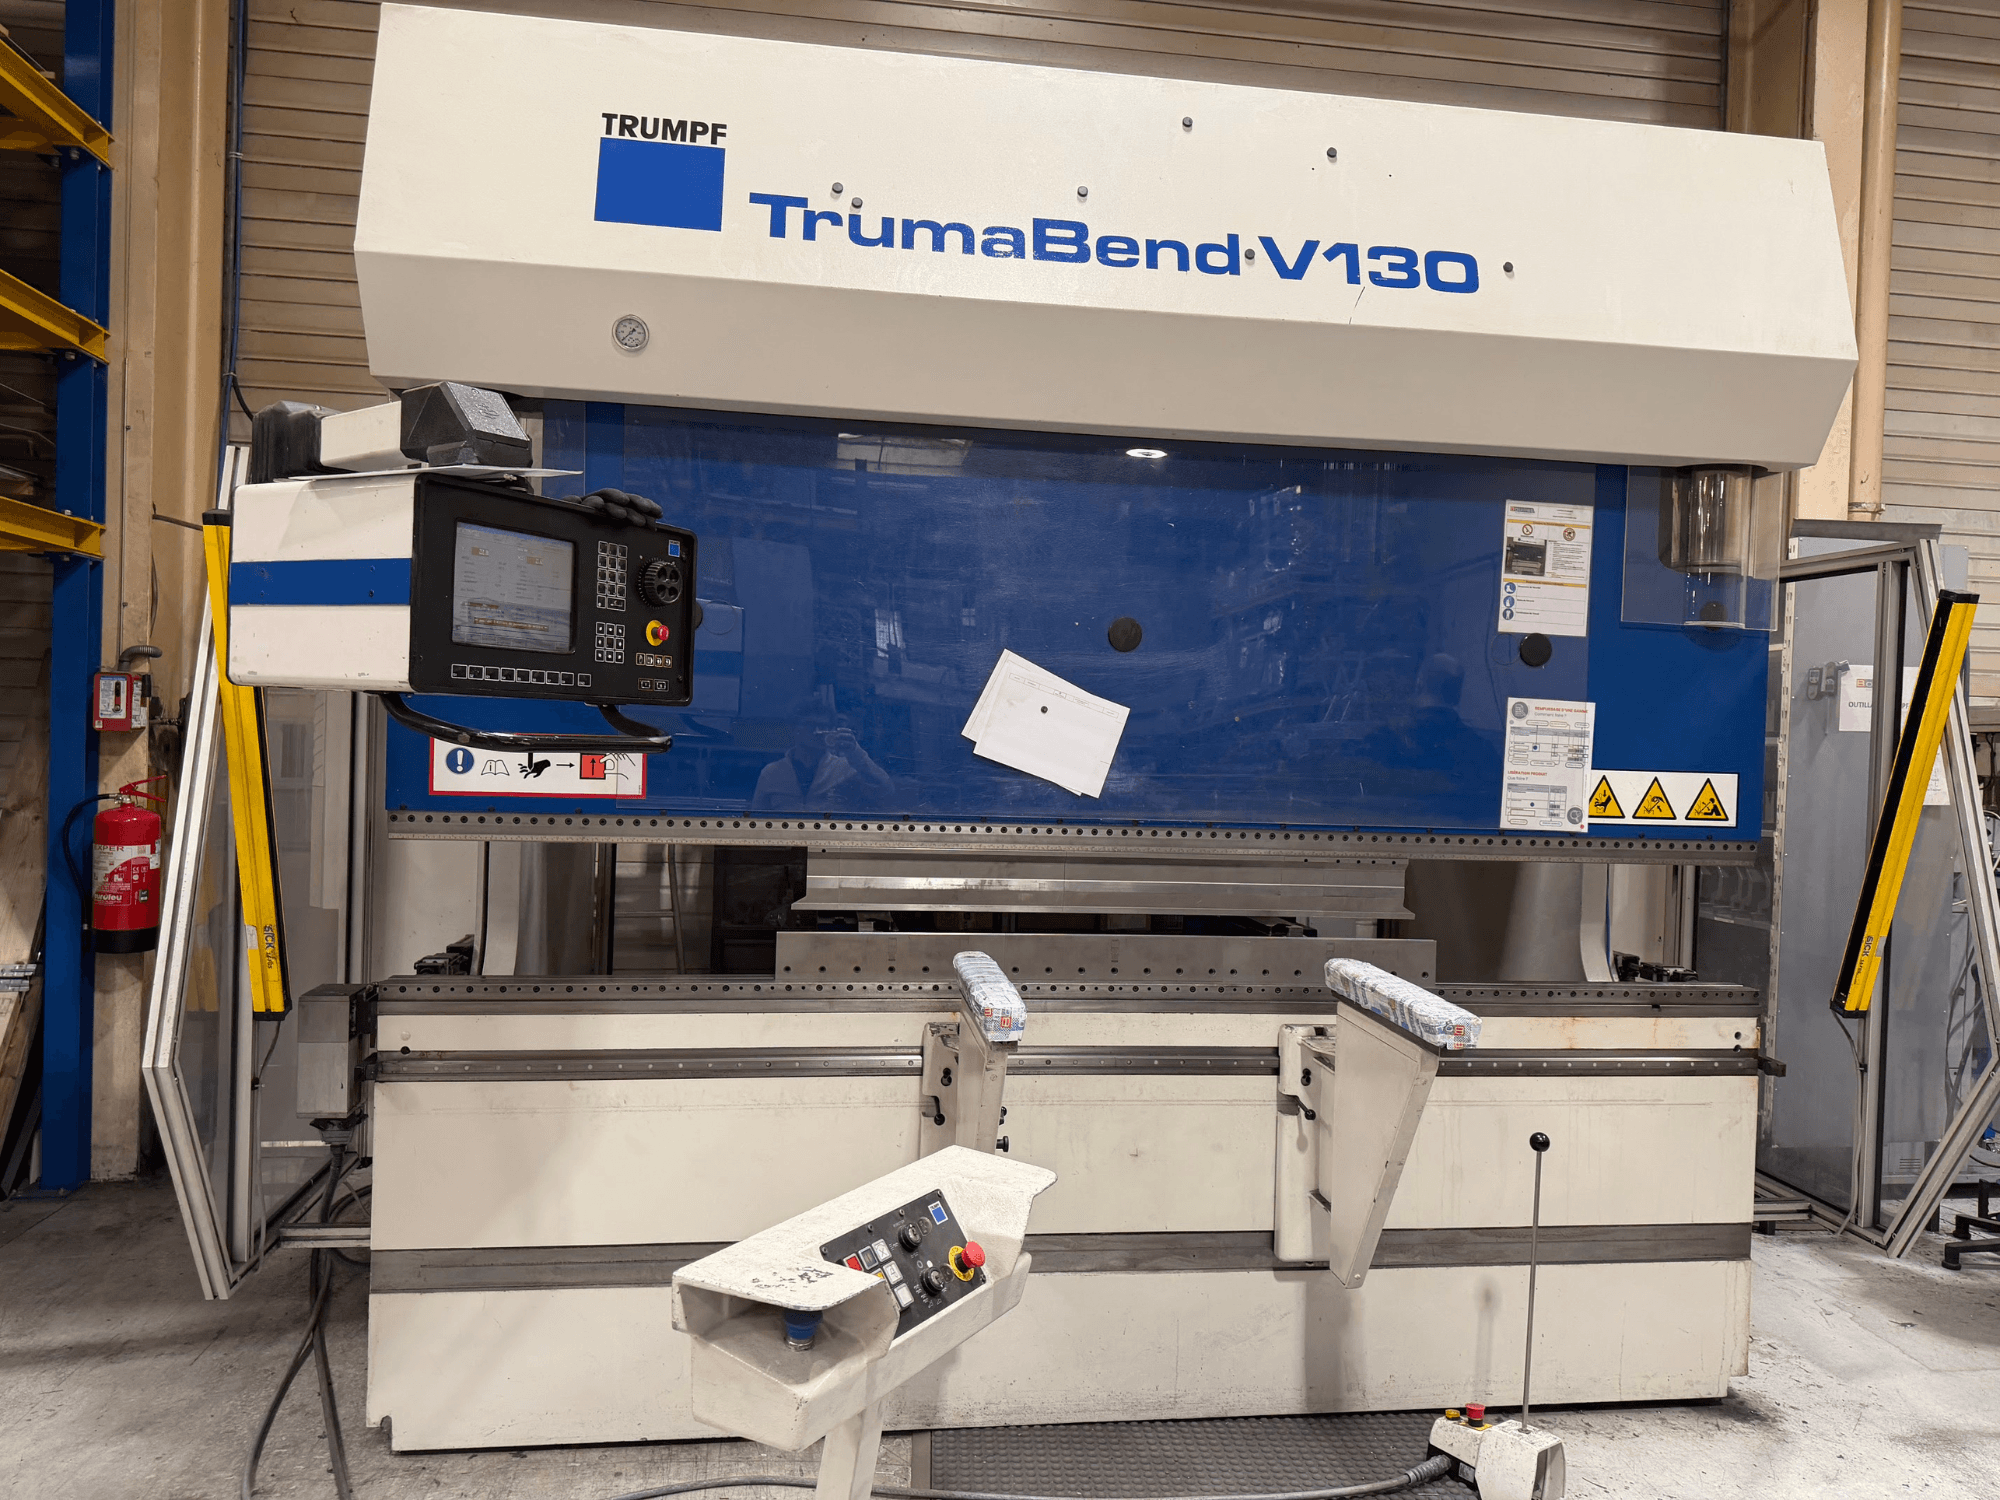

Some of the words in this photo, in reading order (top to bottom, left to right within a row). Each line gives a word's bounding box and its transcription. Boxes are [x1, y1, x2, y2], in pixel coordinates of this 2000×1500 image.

[601, 112, 727, 145] TRUMPF
[749, 192, 1241, 276] TrumaBend
[1257, 235, 1480, 294] V130
[263, 923, 275, 950] SICK
[1861, 935, 1874, 958] SICK
